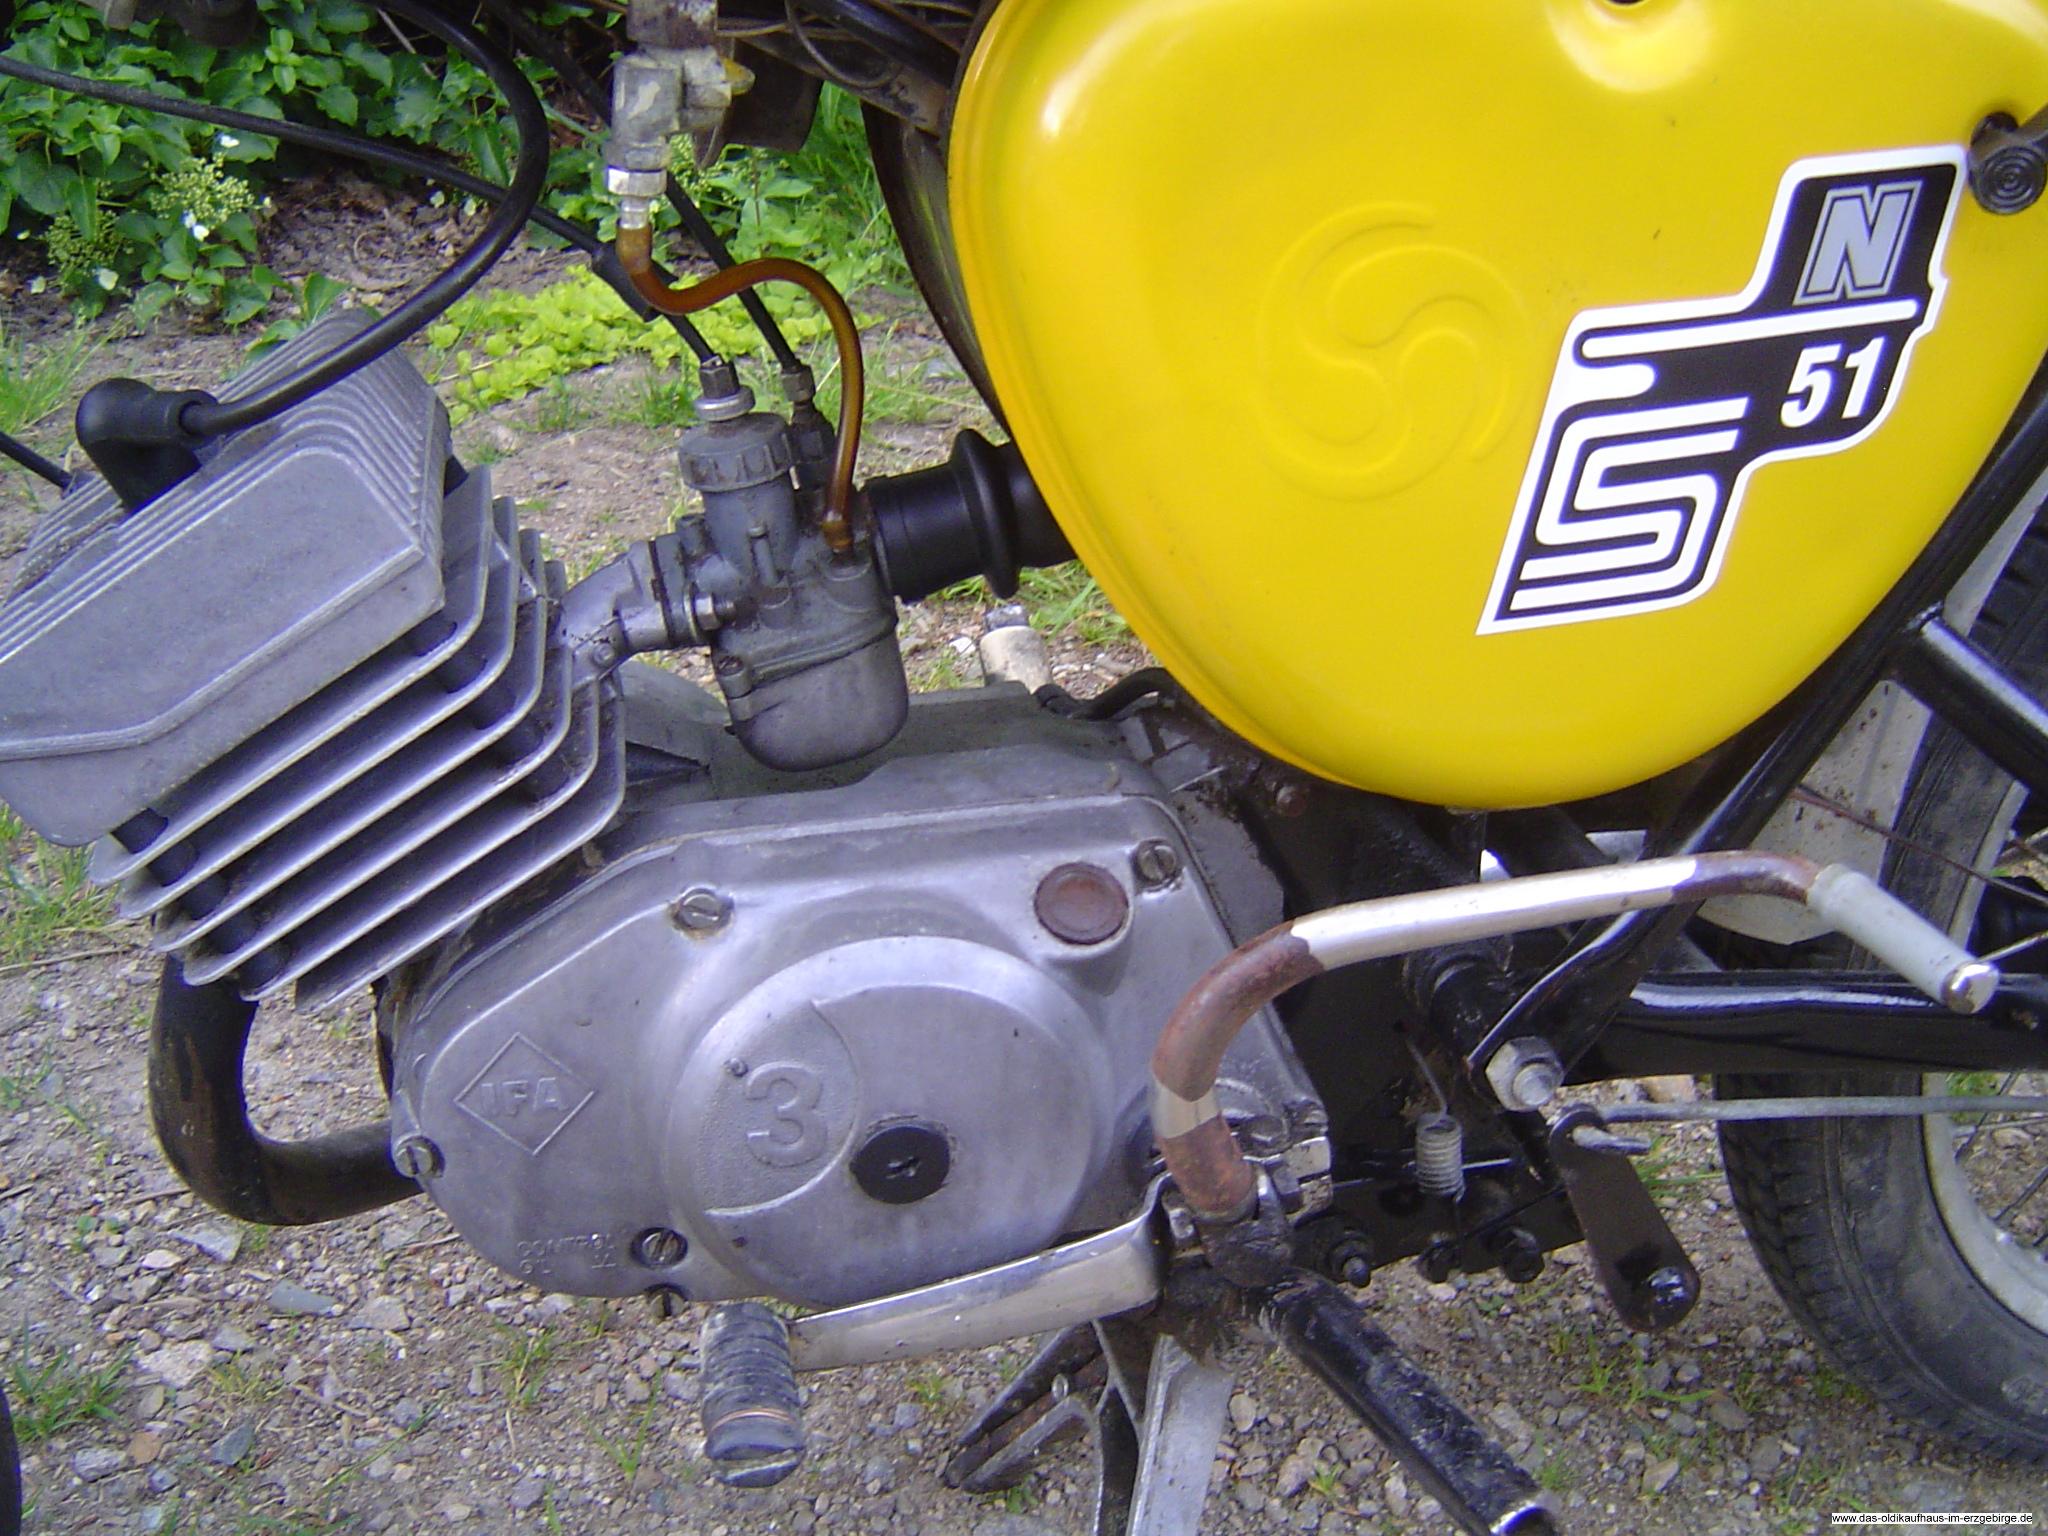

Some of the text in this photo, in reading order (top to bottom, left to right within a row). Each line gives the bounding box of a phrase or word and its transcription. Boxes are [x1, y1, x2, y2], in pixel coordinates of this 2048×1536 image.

[1793, 180, 1923, 306] N
[1780, 336, 1887, 429] 51
[744, 1060, 830, 1168] 3
